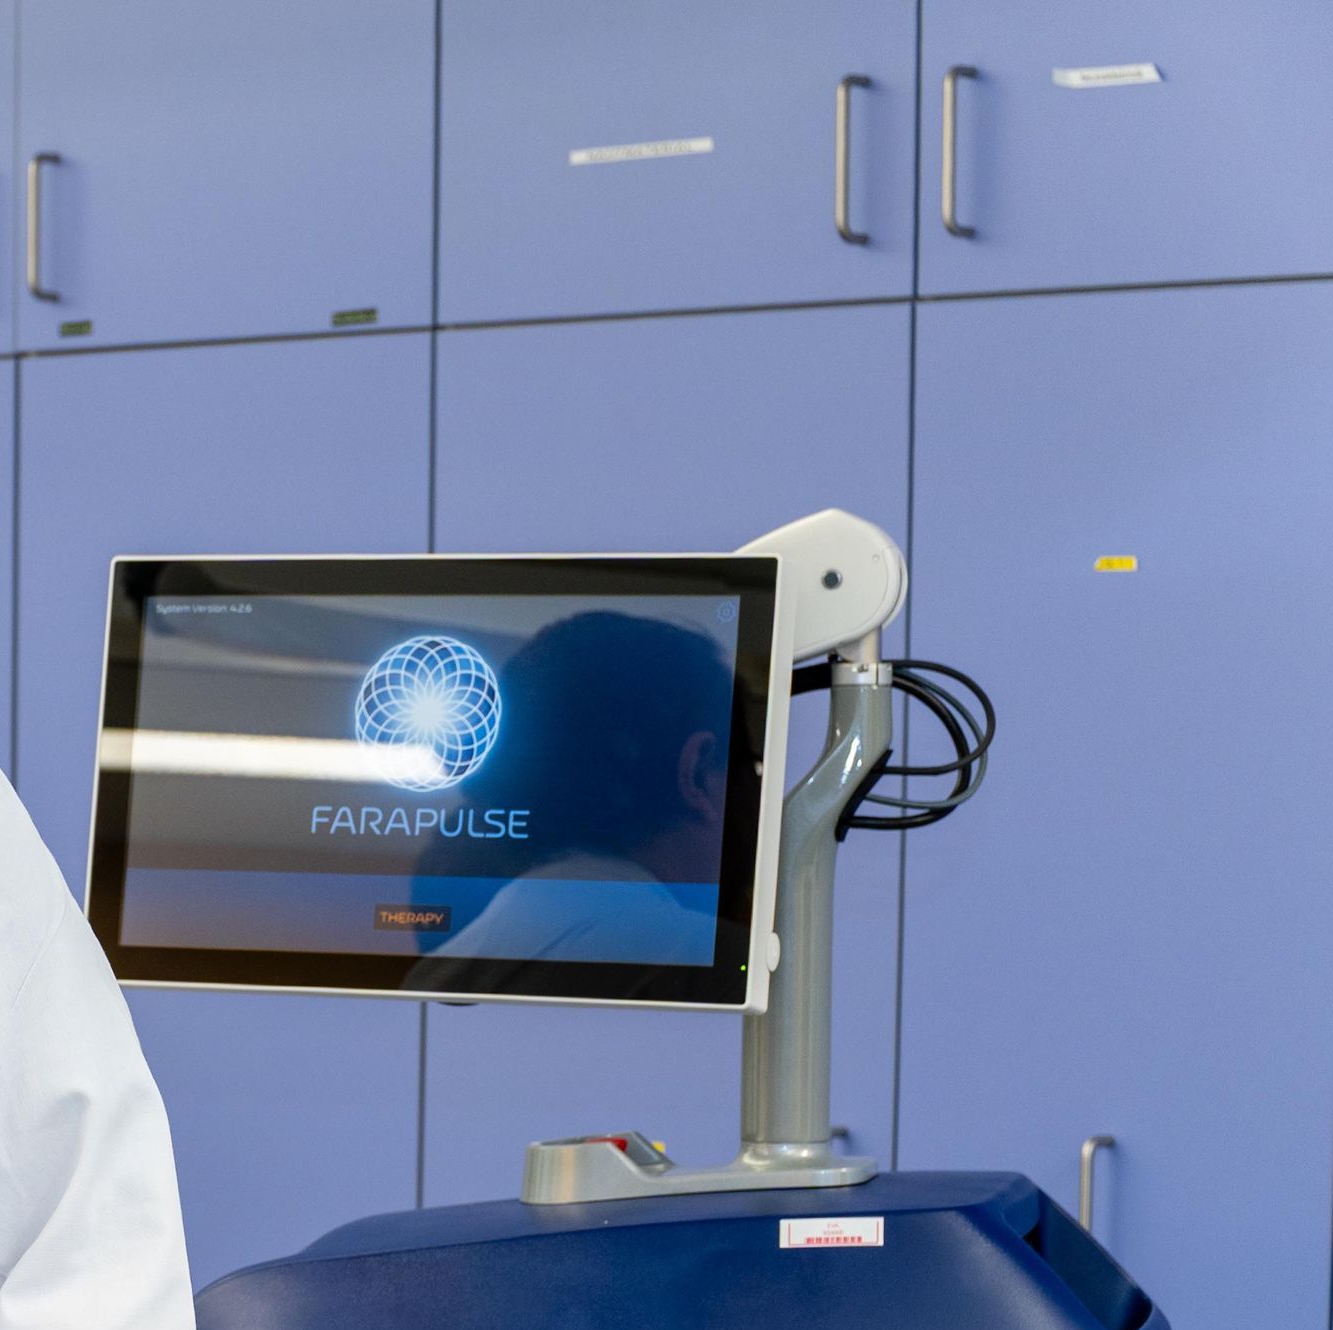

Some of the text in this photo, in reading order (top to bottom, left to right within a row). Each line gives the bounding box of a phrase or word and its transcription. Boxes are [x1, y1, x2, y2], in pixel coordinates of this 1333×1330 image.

[156, 604, 191, 615] System
[310, 805, 531, 839] FARAPULSE
[379, 910, 444, 925] THERAPY
